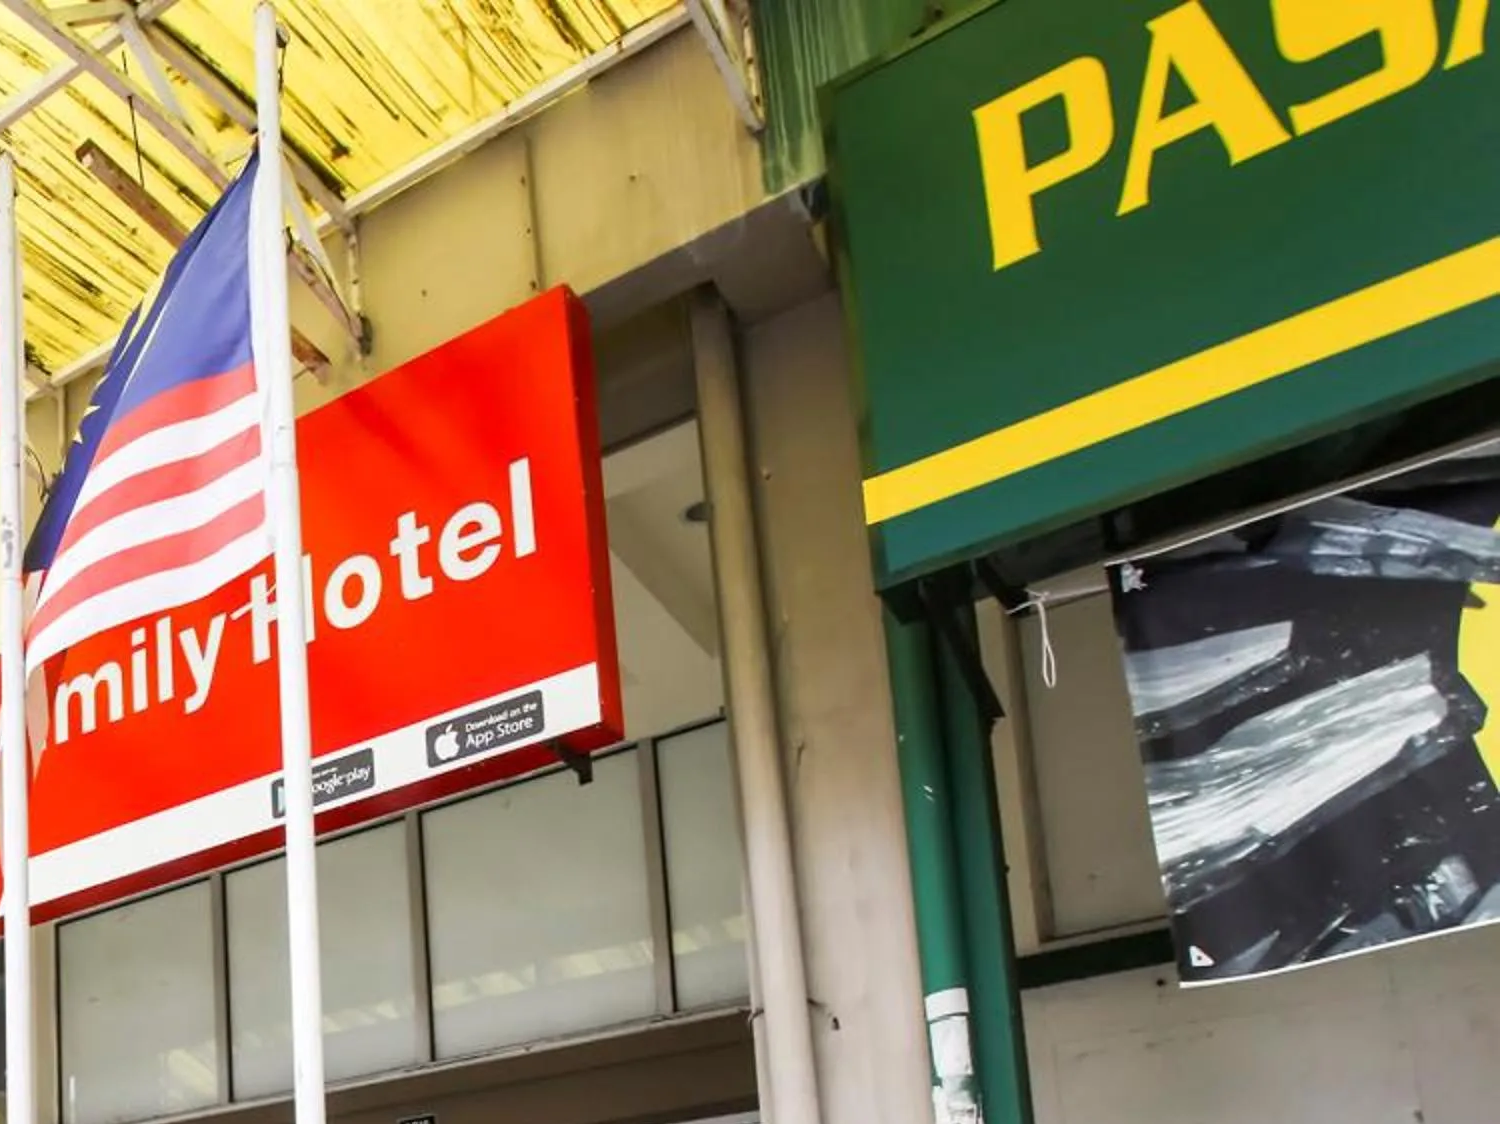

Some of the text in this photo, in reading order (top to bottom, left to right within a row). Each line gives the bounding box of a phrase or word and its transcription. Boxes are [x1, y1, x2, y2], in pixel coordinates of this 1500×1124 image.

[972, 0, 1500, 271] PAS
[53, 613, 227, 745] mily
[250, 456, 537, 666] Hotel
[465, 702, 538, 732] Download on the
[465, 716, 533, 748] App Store
[311, 773, 343, 795] oogle
[345, 765, 371, 785] play
